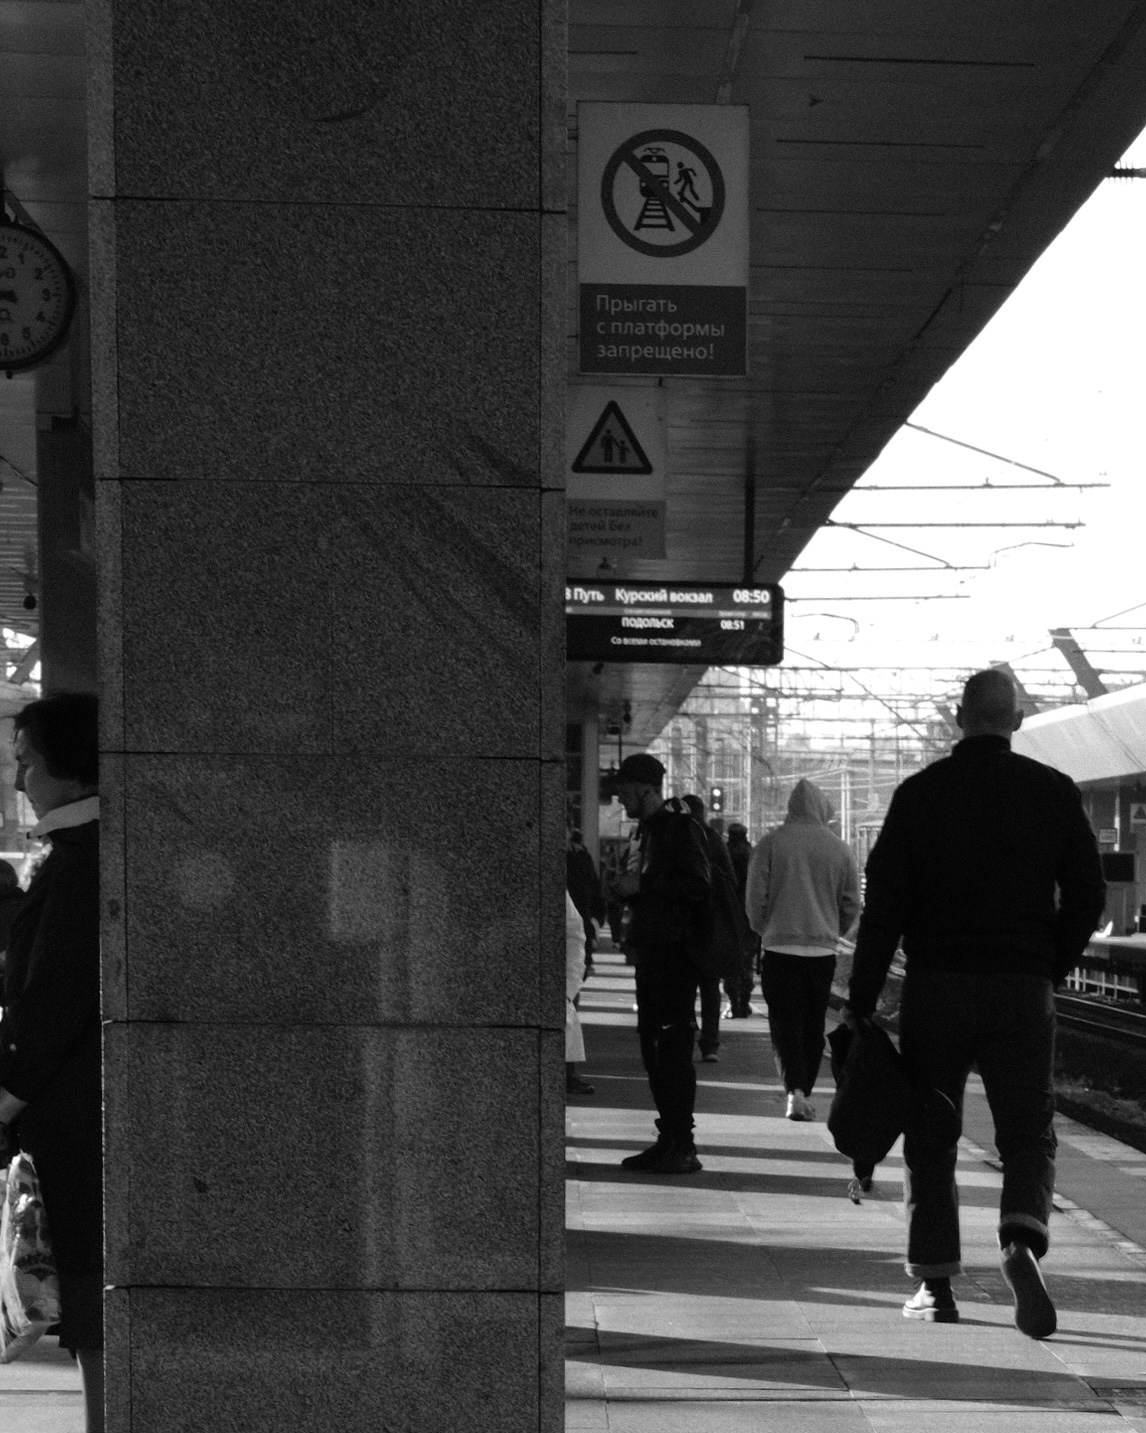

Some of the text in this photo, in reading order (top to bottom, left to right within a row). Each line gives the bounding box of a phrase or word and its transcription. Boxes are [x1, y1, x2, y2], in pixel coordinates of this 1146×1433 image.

[596, 294, 678, 316] Прыгать
[596, 319, 726, 340] с платформы
[597, 343, 716, 363] запрещено!
[574, 587, 604, 604] Путь
[615, 587, 668, 604] Курский
[669, 591, 713, 603] вокзал
[733, 589, 770, 604] 08:50
